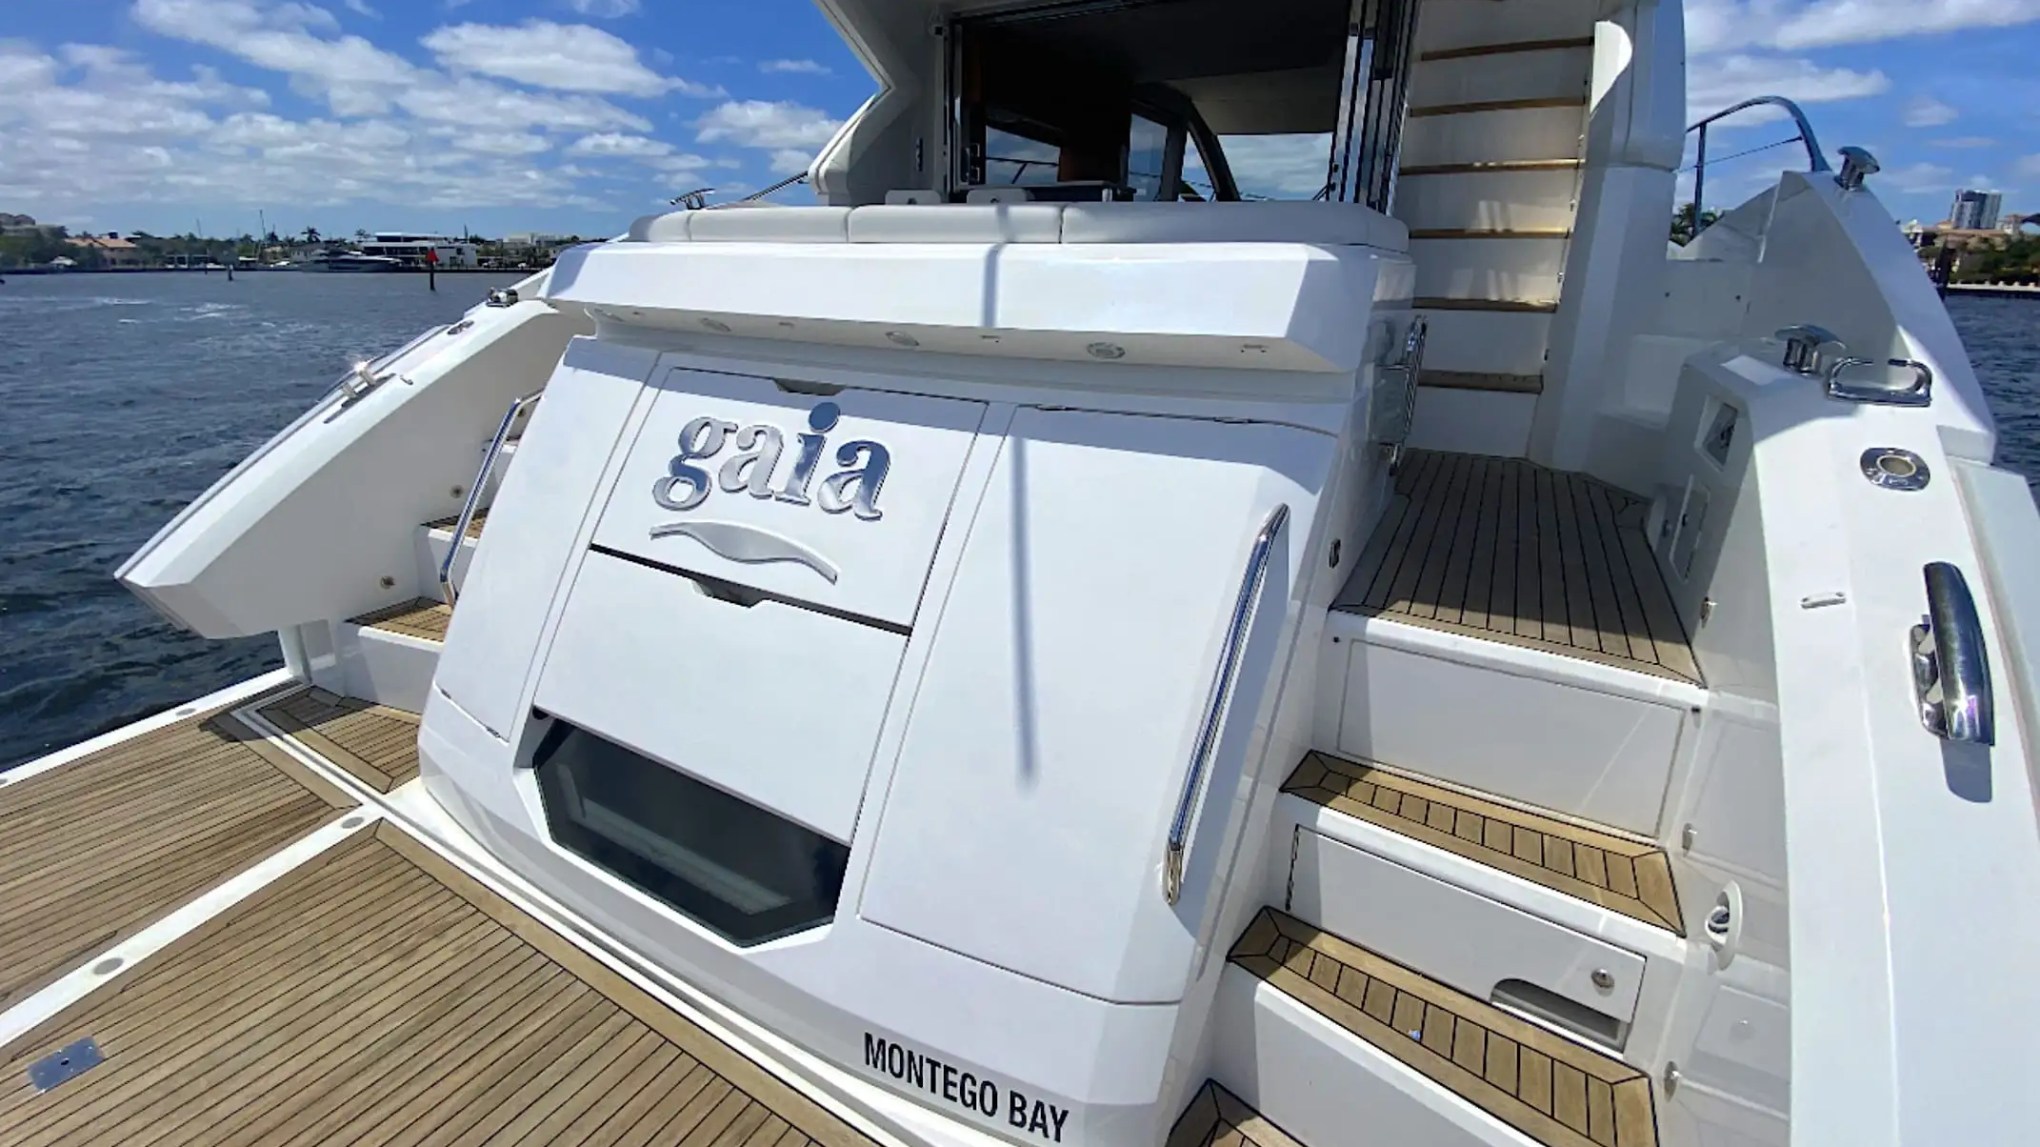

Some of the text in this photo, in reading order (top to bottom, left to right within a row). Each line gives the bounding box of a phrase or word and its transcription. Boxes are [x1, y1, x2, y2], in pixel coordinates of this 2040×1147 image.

[653, 402, 891, 521] gaia
[864, 1032, 1069, 1143] MONTEGO BAY
